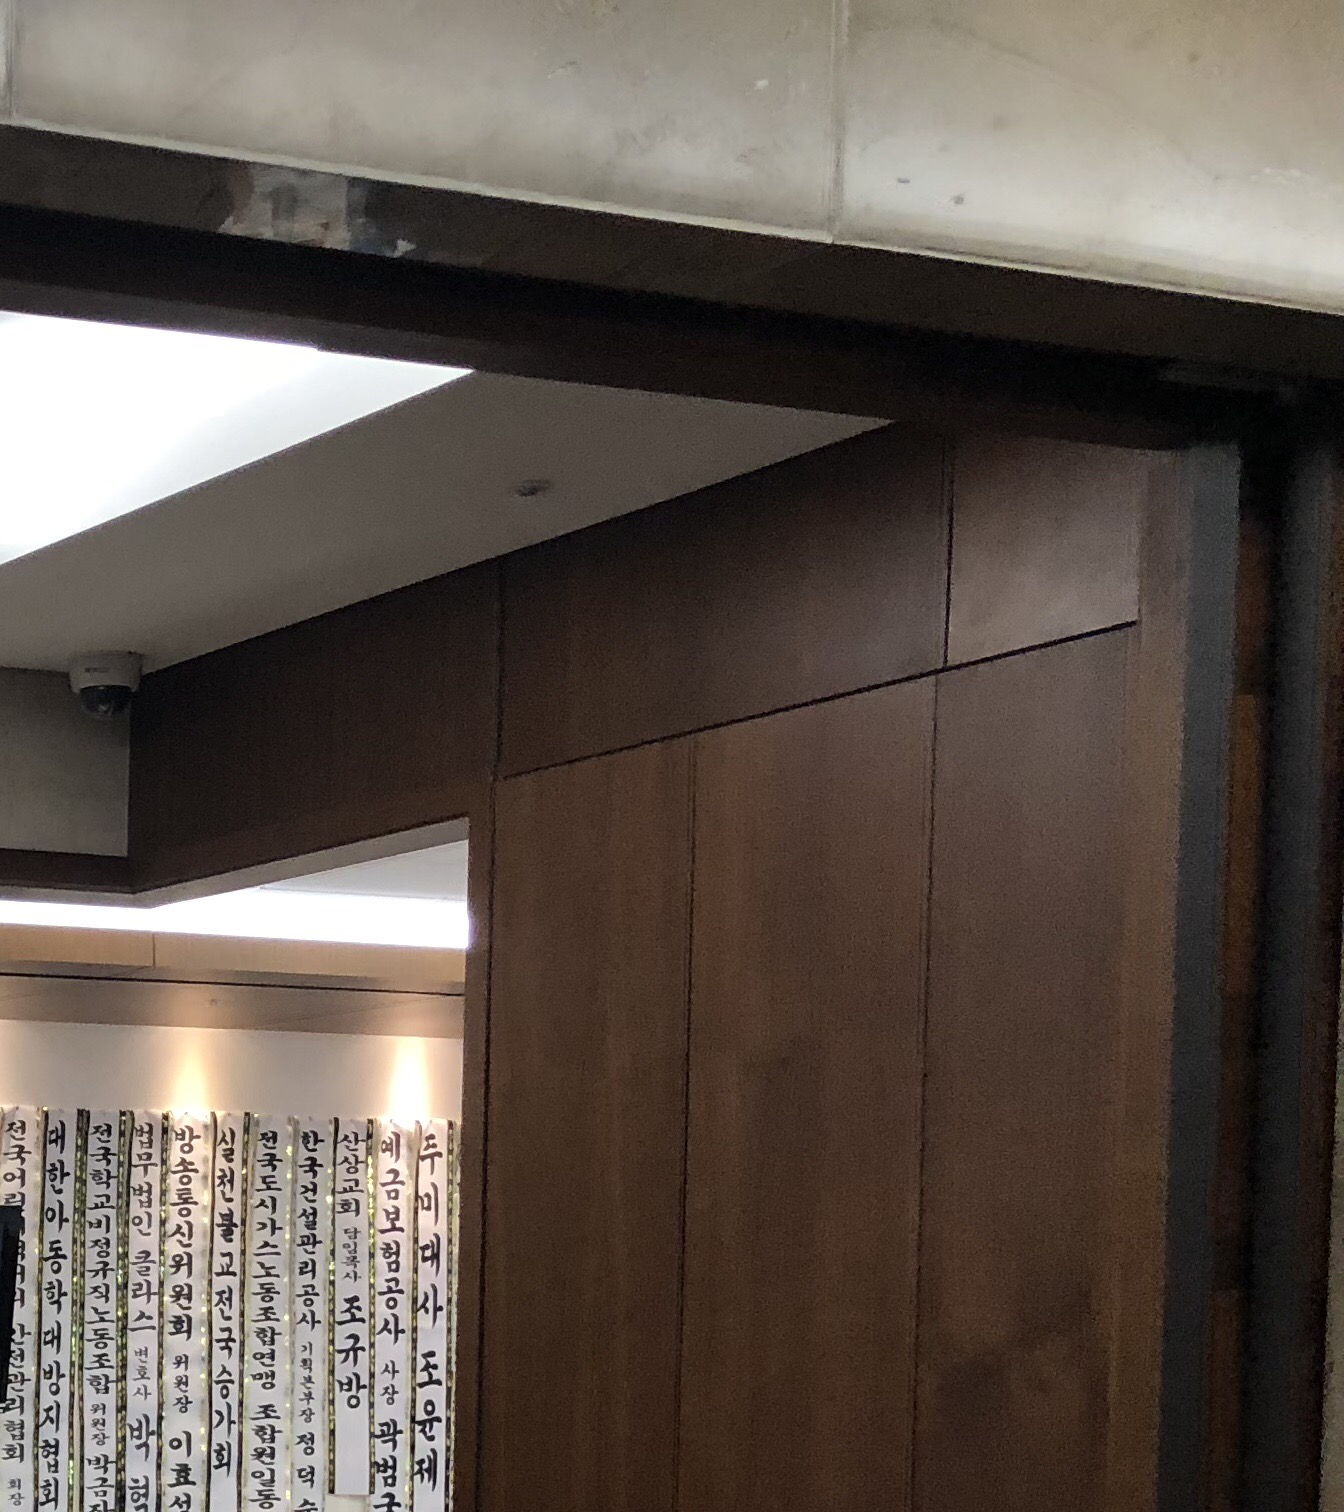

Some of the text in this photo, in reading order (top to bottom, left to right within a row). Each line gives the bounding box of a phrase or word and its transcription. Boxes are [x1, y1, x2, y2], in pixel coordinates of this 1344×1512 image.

[130, 1122, 158, 1236] 법무법인
[335, 1131, 365, 1217] 산상교회
[168, 1125, 201, 1341] 방송통신위원회
[127, 1249, 159, 1332] 클라스
[132, 1346, 151, 1400] 변호사
[172, 1354, 193, 1413] 위원장
[335, 1295, 366, 1409] 조규방
[380, 1360, 399, 1405] 사장
[90, 1403, 110, 1446] 위원장
